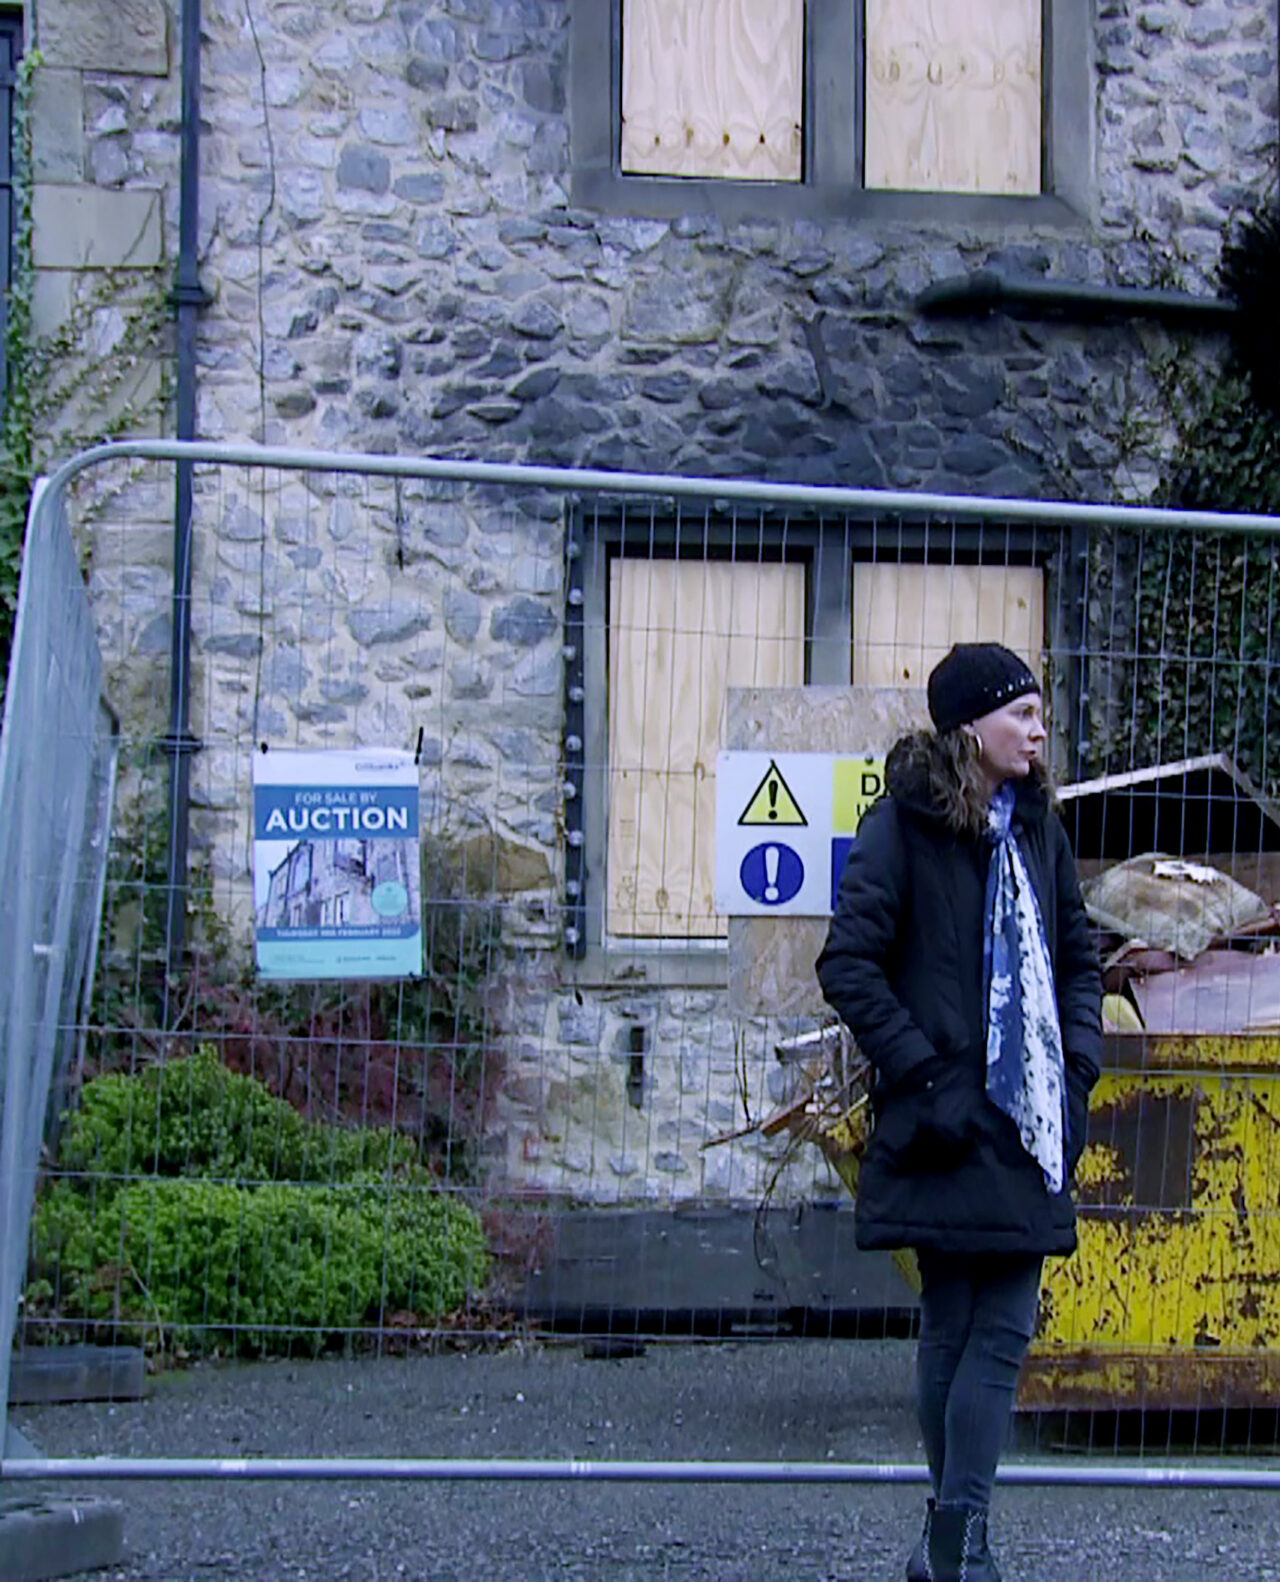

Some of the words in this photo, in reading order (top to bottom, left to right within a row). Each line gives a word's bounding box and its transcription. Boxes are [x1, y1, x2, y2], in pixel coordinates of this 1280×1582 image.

[294, 791, 322, 806] FOR
[324, 791, 357, 806] SALE
[360, 791, 378, 804] BY
[265, 806, 408, 832] AUCTION
